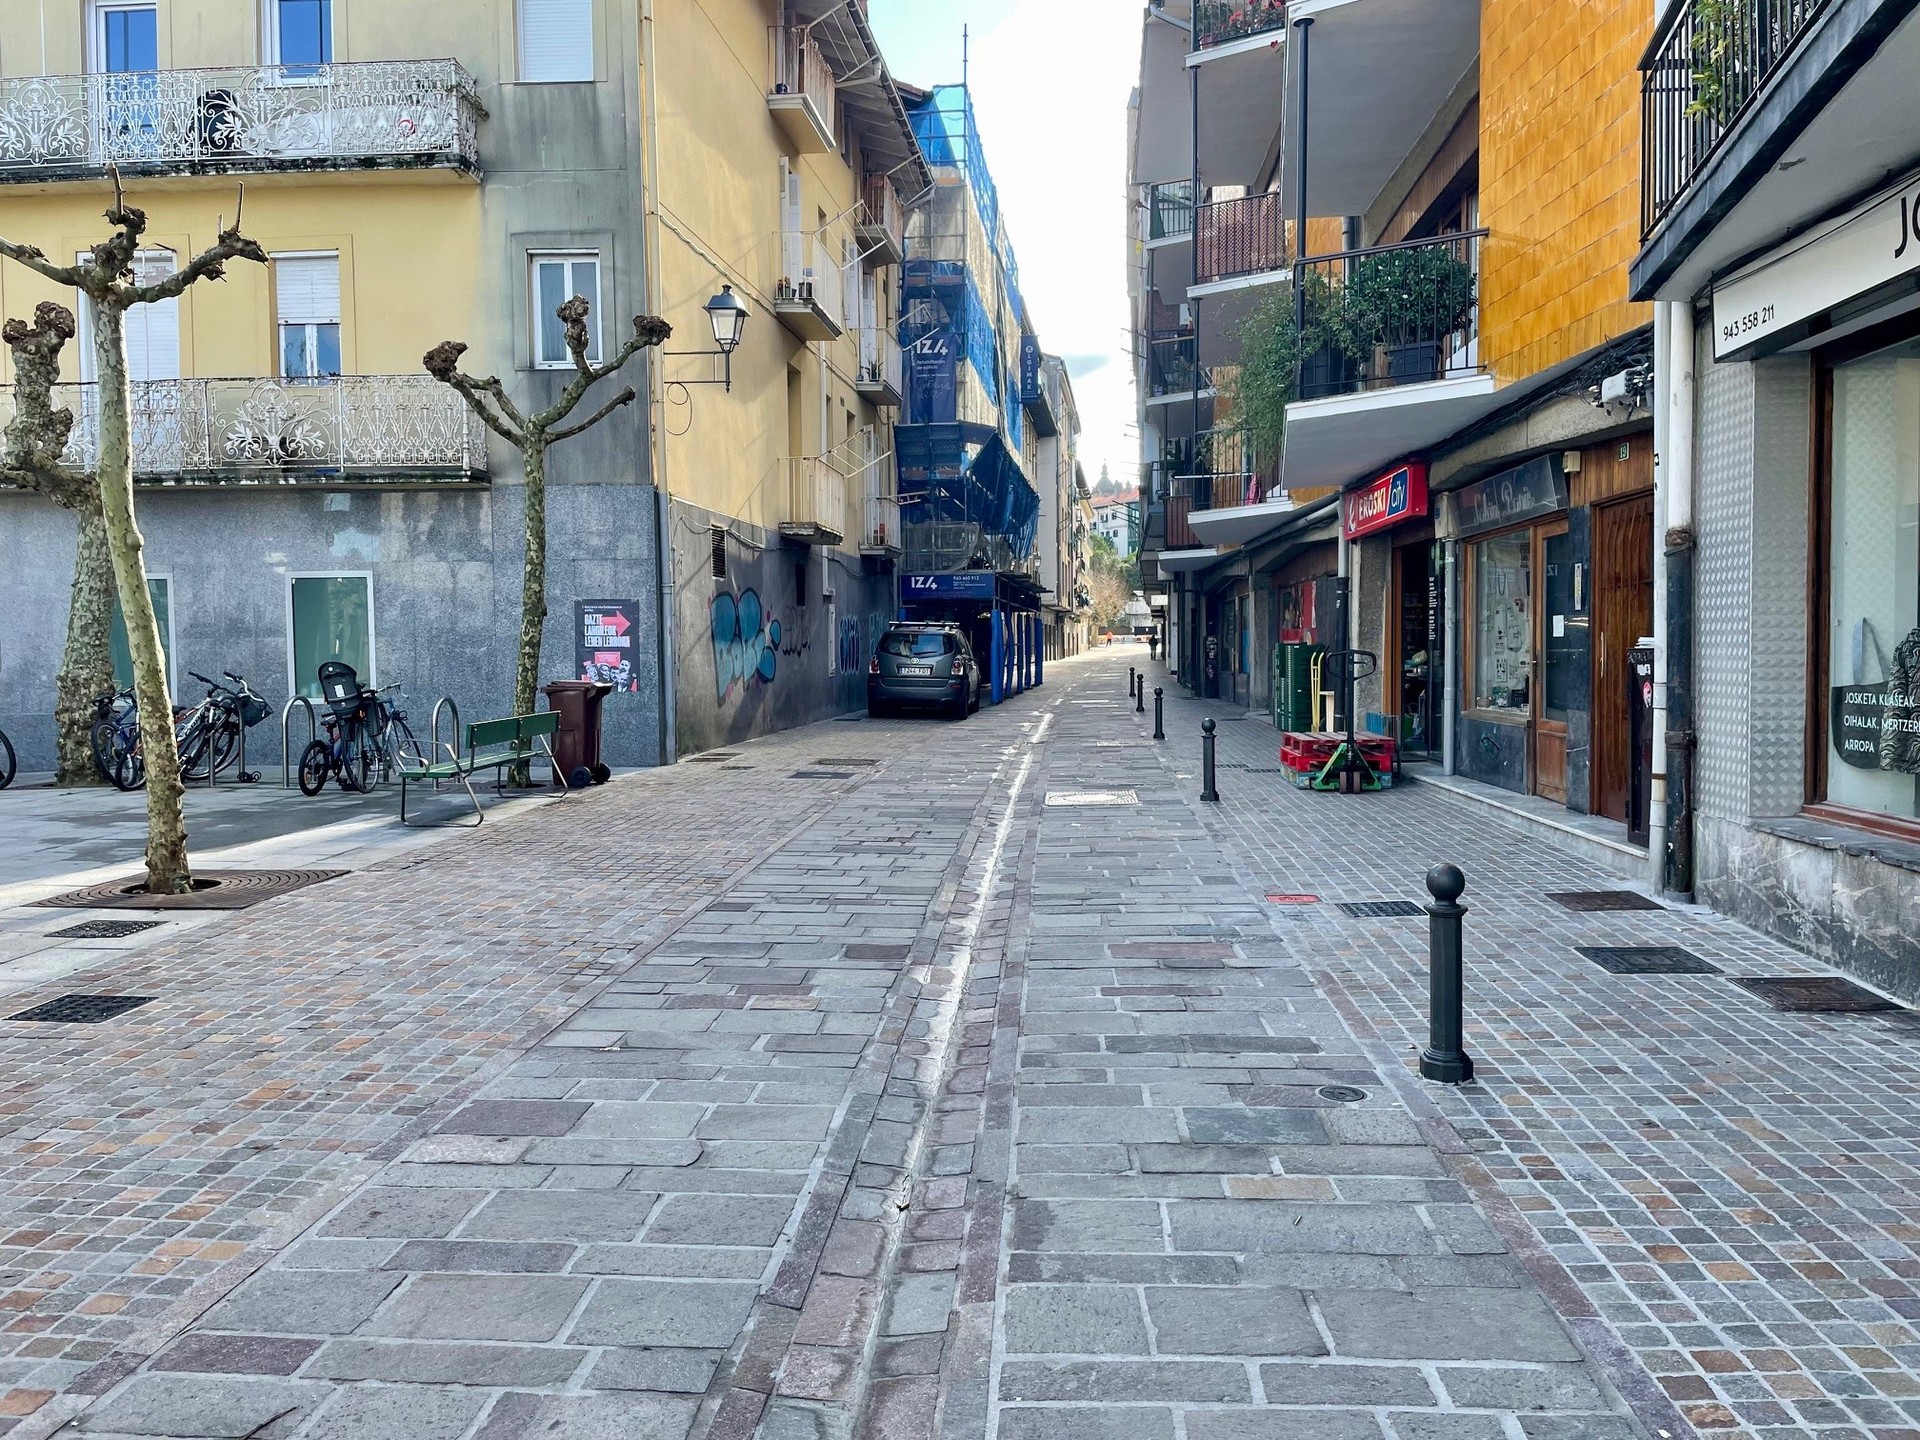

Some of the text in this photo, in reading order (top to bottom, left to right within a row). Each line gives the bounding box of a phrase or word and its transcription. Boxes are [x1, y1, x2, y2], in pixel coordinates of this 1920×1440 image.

[1723, 304, 1774, 341] 943 558 211
[1620, 444, 1628, 459] 19
[1359, 481, 1406, 521] EROSKI city
[1844, 692, 1915, 708] JOSKETA KLASEAK
[1844, 738, 1875, 753] ARROPA
